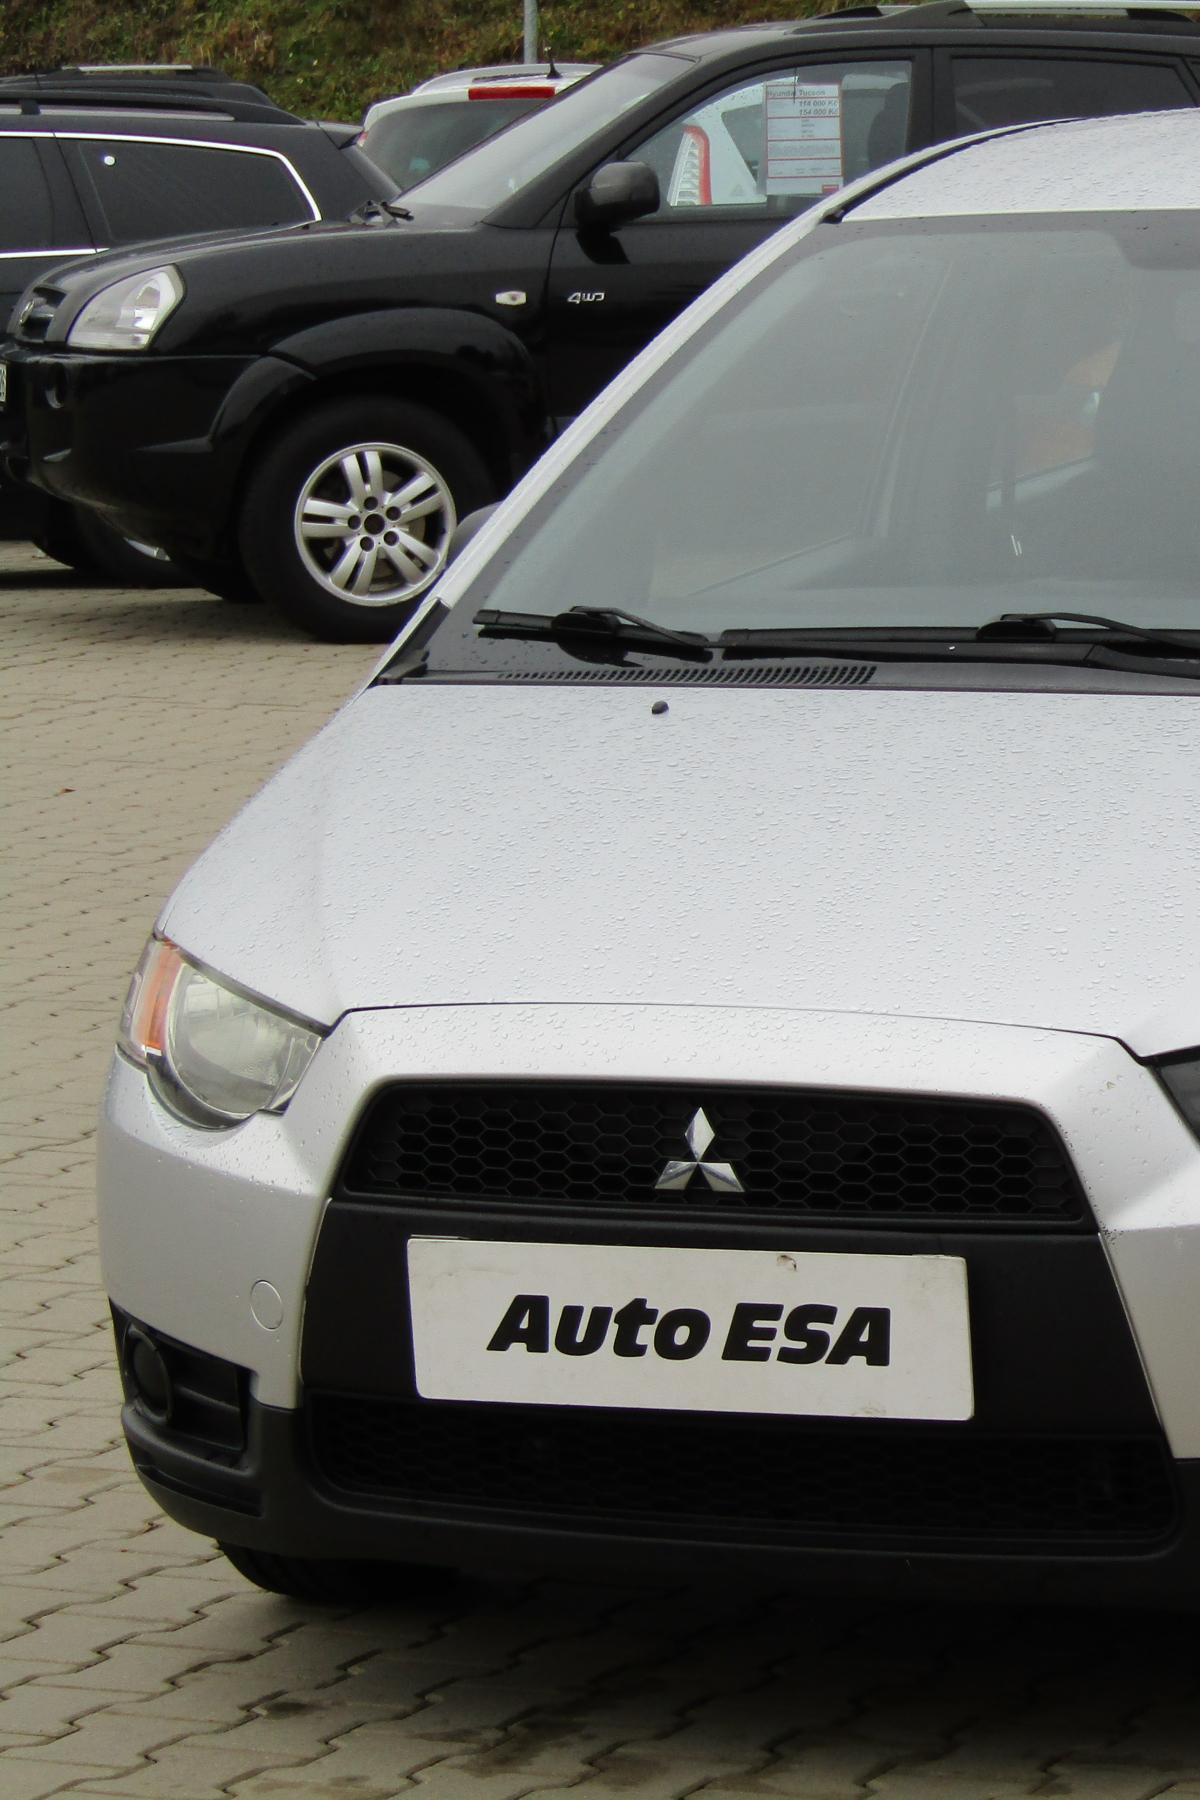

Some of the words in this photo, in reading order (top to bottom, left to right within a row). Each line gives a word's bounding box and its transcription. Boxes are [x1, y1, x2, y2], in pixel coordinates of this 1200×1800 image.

[766, 89, 796, 98] Hyunda
[567, 292, 605, 304] 4WD
[487, 1294, 711, 1361] Auto
[721, 1302, 890, 1367] ESA
